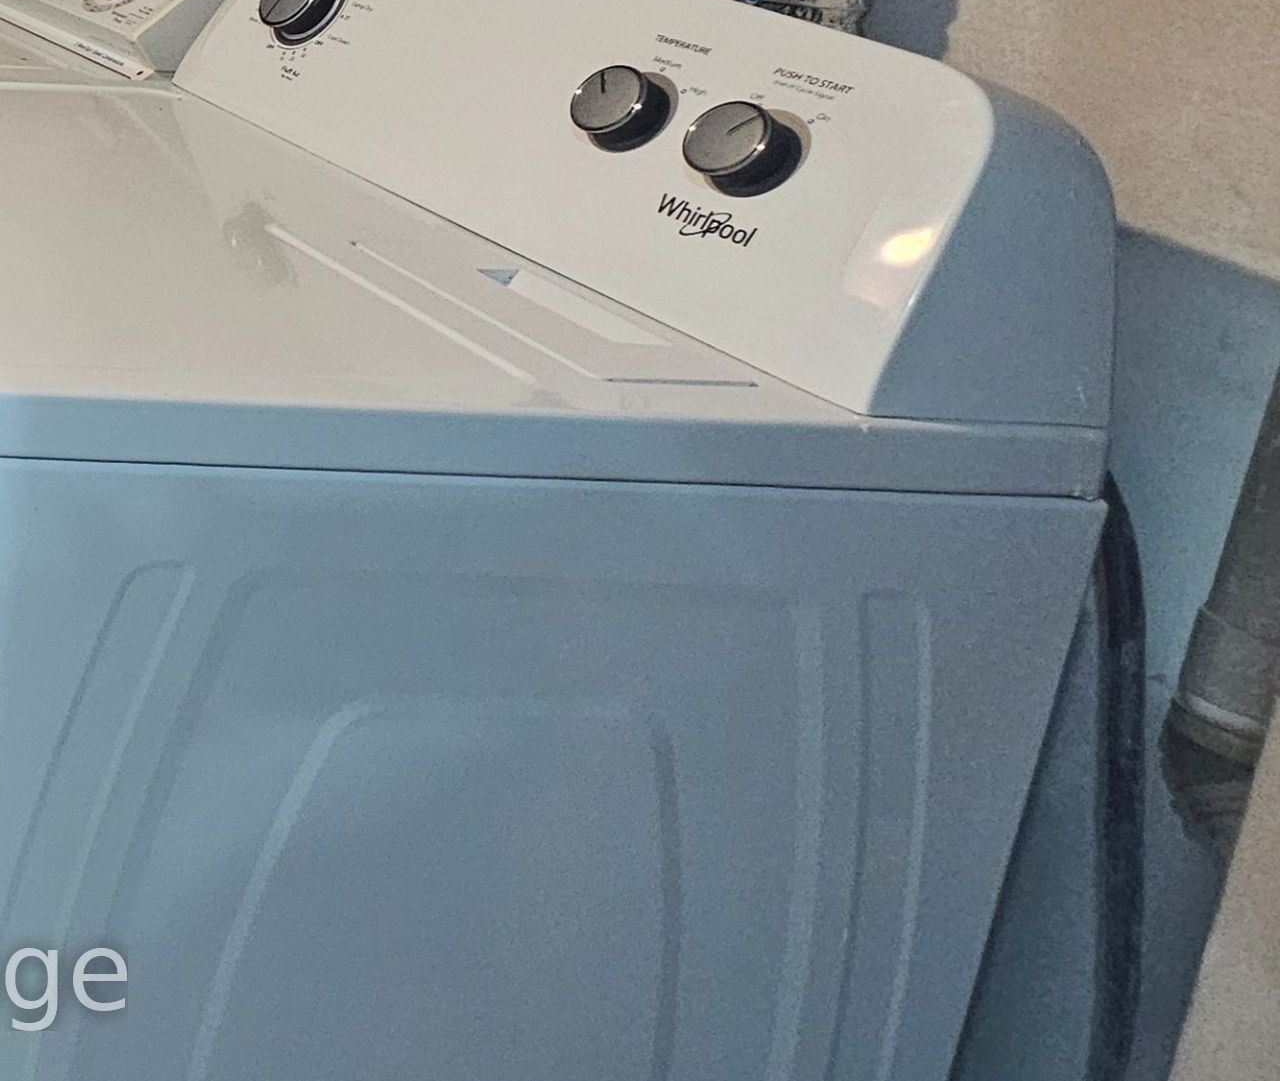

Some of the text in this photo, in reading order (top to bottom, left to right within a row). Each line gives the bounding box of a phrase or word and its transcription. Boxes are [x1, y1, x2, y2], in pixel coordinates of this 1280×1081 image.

[655, 34, 712, 56] TEMPERATURE
[652, 55, 682, 69] Medium
[773, 67, 855, 94] PUSH TO START
[658, 193, 758, 247] Whirlpool
